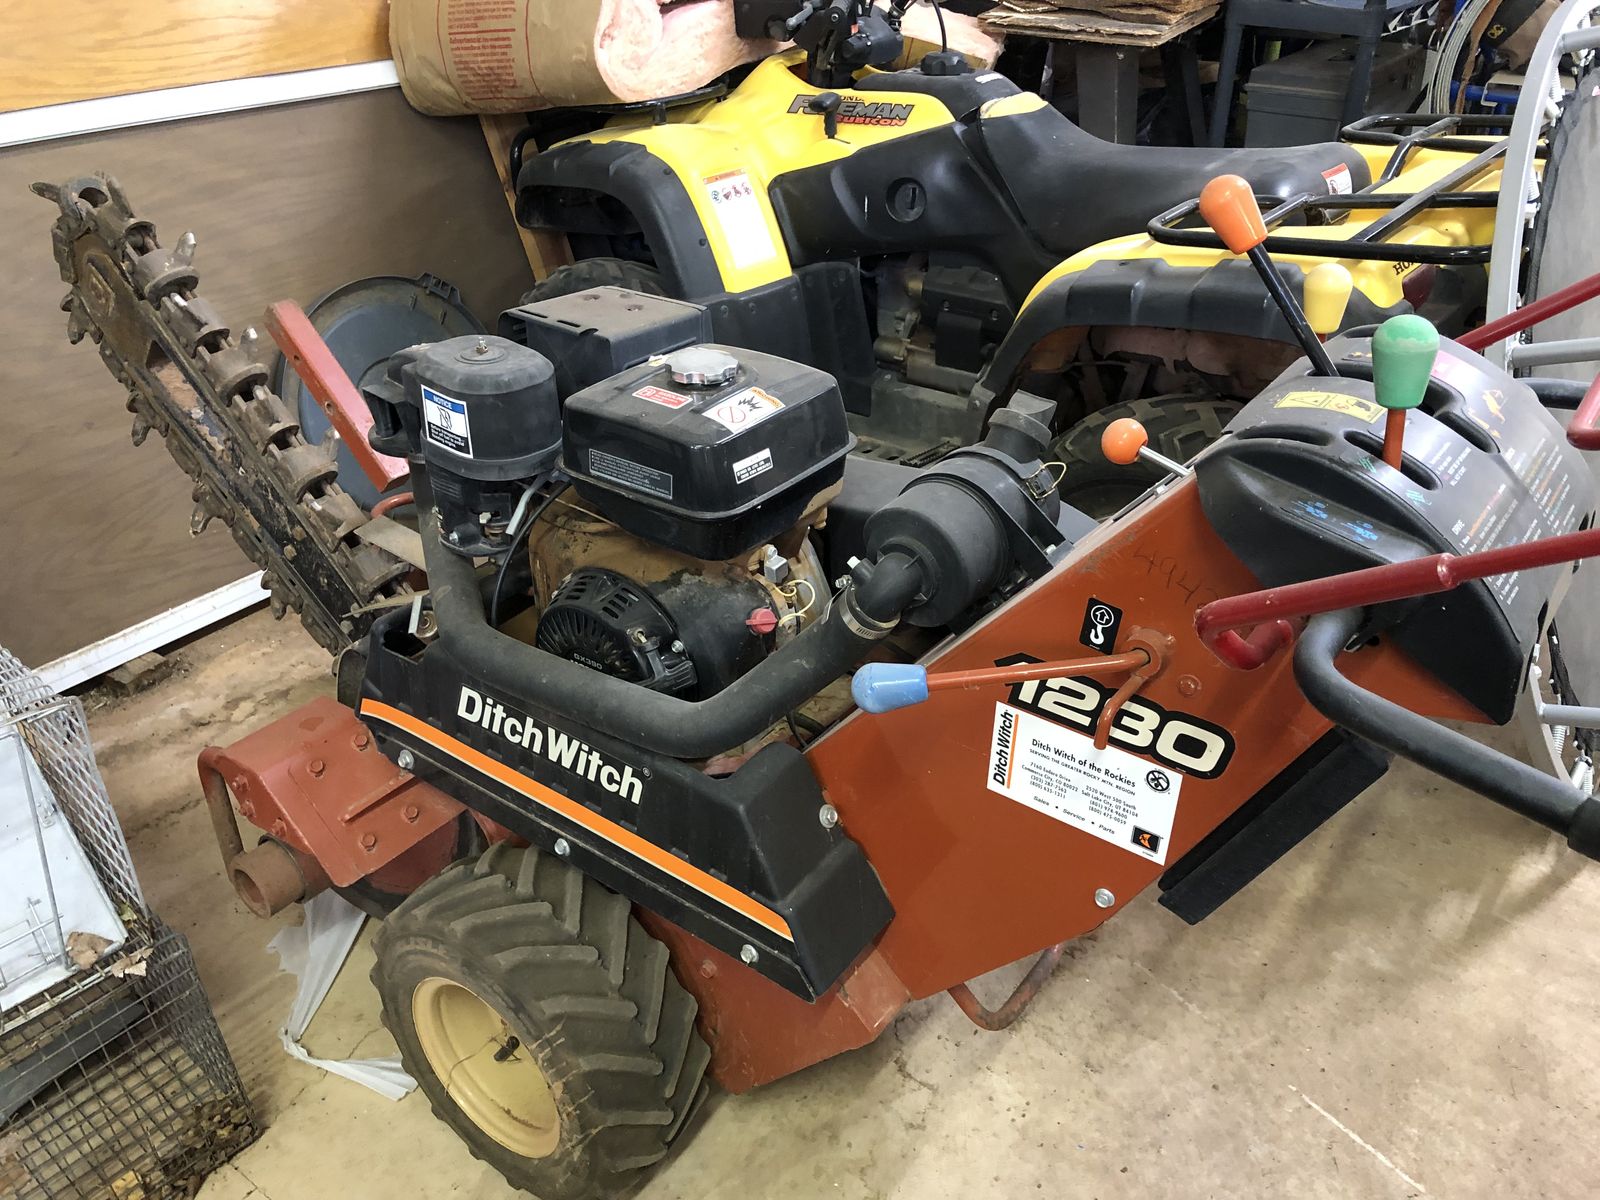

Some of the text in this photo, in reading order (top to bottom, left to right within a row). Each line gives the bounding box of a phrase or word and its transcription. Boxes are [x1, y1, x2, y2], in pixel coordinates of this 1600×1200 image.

[433, 395, 453, 410] NOTICE
[457, 686, 543, 754] Ditch
[1014, 661, 1226, 773] 1230
[993, 710, 1013, 786] Ditch Witch
[1032, 738, 1135, 787] Ditch Witch of the Rockies
[1030, 749, 1050, 760] SERVING
[1061, 762, 1082, 773] GREATER
[1083, 771, 1100, 780] ROCKY
[1115, 785, 1135, 796] REGION
[1044, 774, 1052, 782] City,
[1059, 774, 1071, 782] Drive
[1034, 796, 1114, 834] Sales Service Parts
[1091, 794, 1102, 802] Lake
[1103, 799, 1113, 807] City,
[1099, 791, 1111, 799] West
[1123, 801, 1136, 810] South
